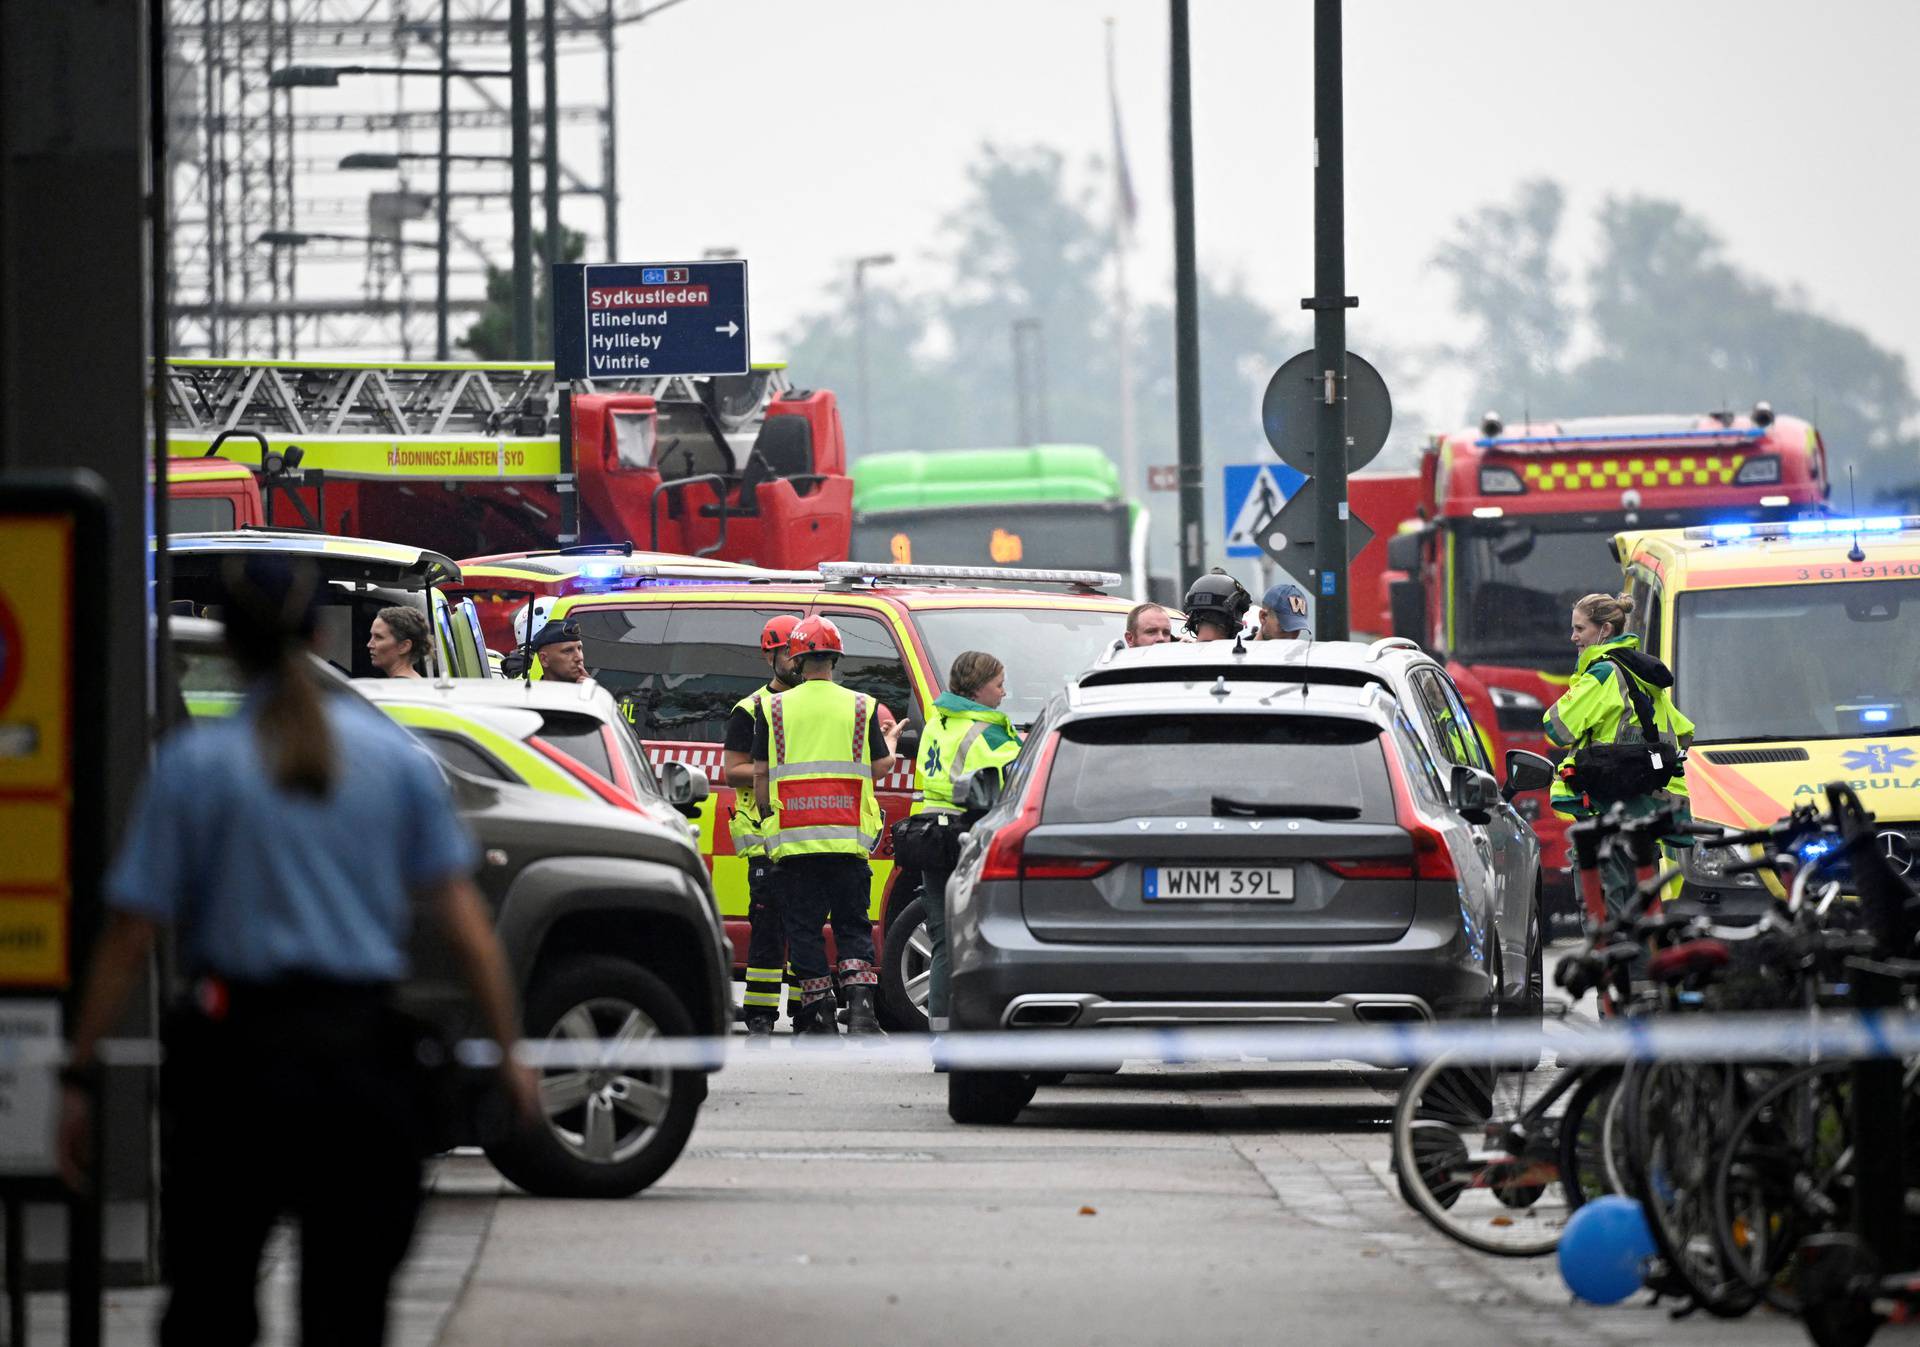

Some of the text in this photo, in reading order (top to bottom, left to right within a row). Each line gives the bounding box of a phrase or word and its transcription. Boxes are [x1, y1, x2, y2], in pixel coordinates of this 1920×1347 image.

[672, 271, 681, 281] 3
[591, 289, 708, 308] Sydkustleden
[591, 311, 668, 327] Elinelund
[592, 334, 662, 350] Hyllieby
[593, 355, 650, 369] Vintrie
[387, 447, 524, 466] RÄDDNINGSTJÄNSTEN SYD
[1797, 568, 1809, 580] 3
[787, 795, 854, 811] INSATSCHEF
[1137, 821, 1300, 830] VOLVO
[1167, 870, 1280, 895] WNM 39L
